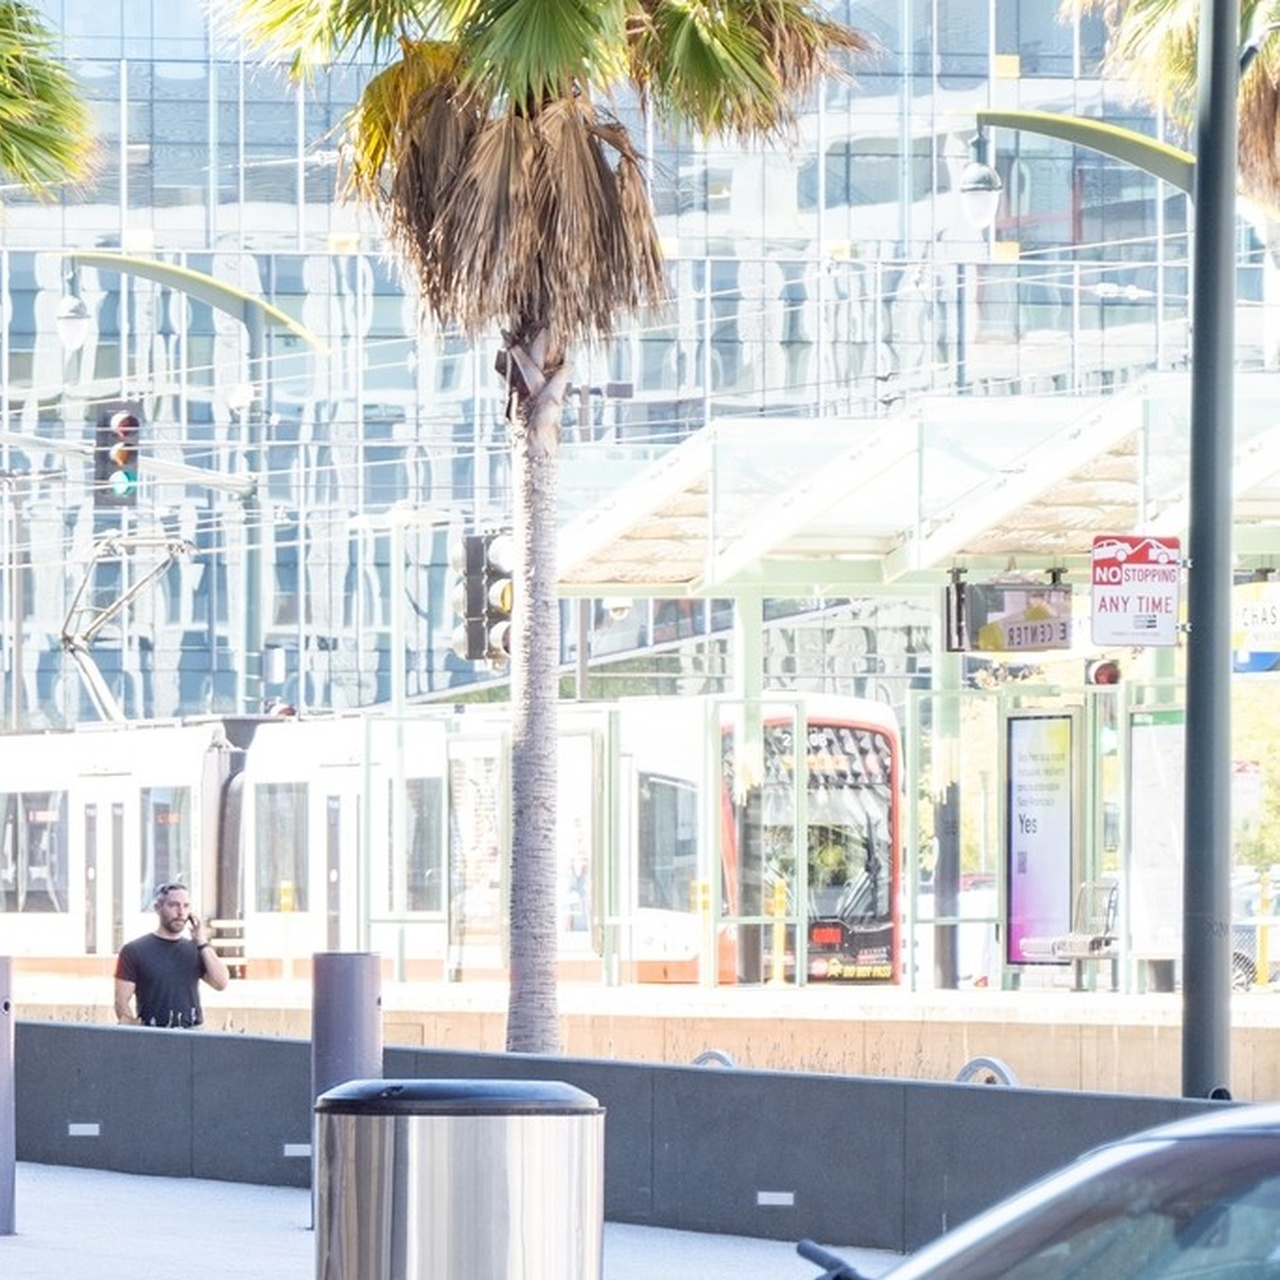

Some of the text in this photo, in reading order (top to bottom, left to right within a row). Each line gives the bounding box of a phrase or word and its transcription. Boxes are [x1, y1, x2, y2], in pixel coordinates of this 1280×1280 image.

[1095, 566, 1176, 583] NO STOPPING
[1098, 596, 1172, 613] ANY TIME
[1018, 813, 1037, 834] Yes
